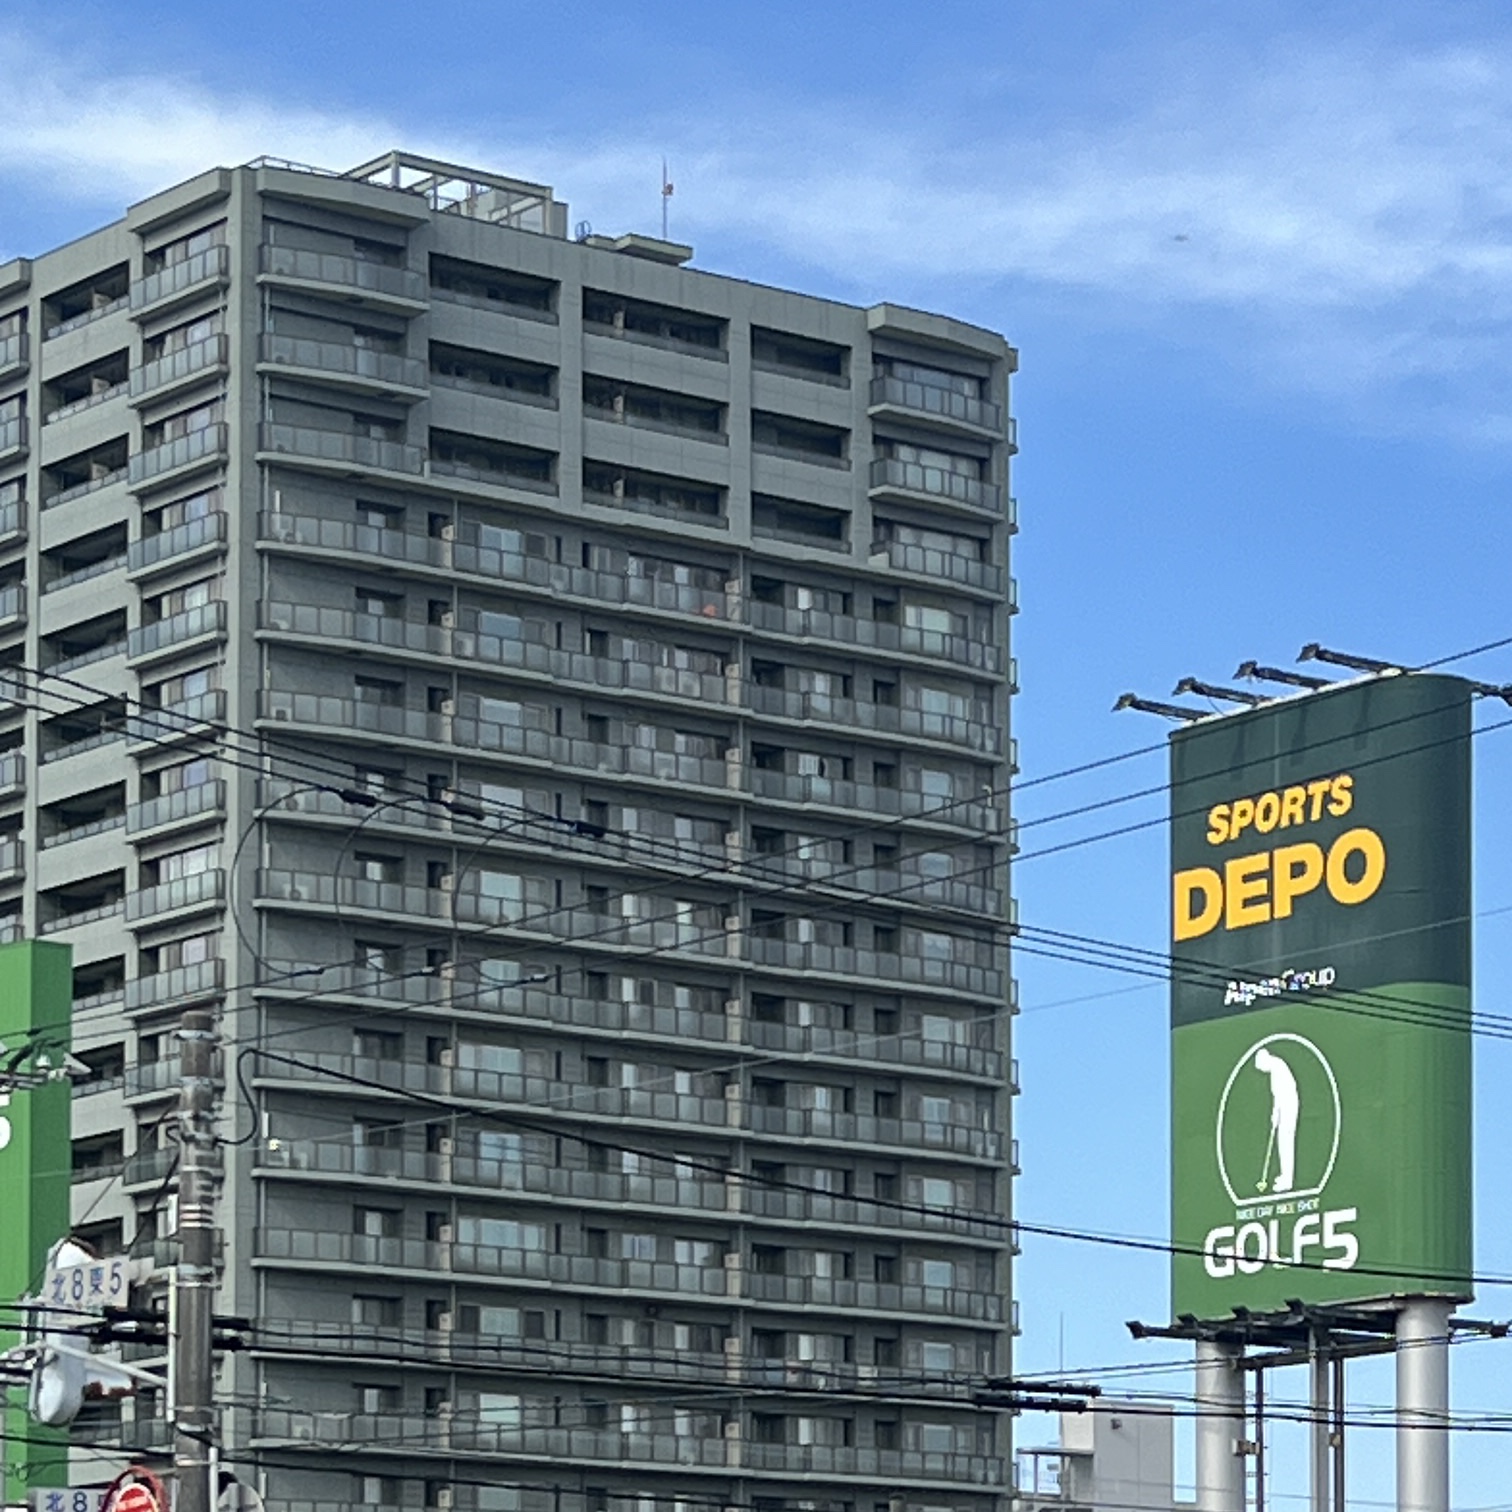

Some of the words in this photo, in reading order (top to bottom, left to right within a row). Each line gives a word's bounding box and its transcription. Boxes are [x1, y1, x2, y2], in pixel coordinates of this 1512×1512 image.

[1206, 774, 1354, 845] SPORTS
[1173, 827, 1386, 942] DEPO
[1204, 1207, 1359, 1278] GOLF5
